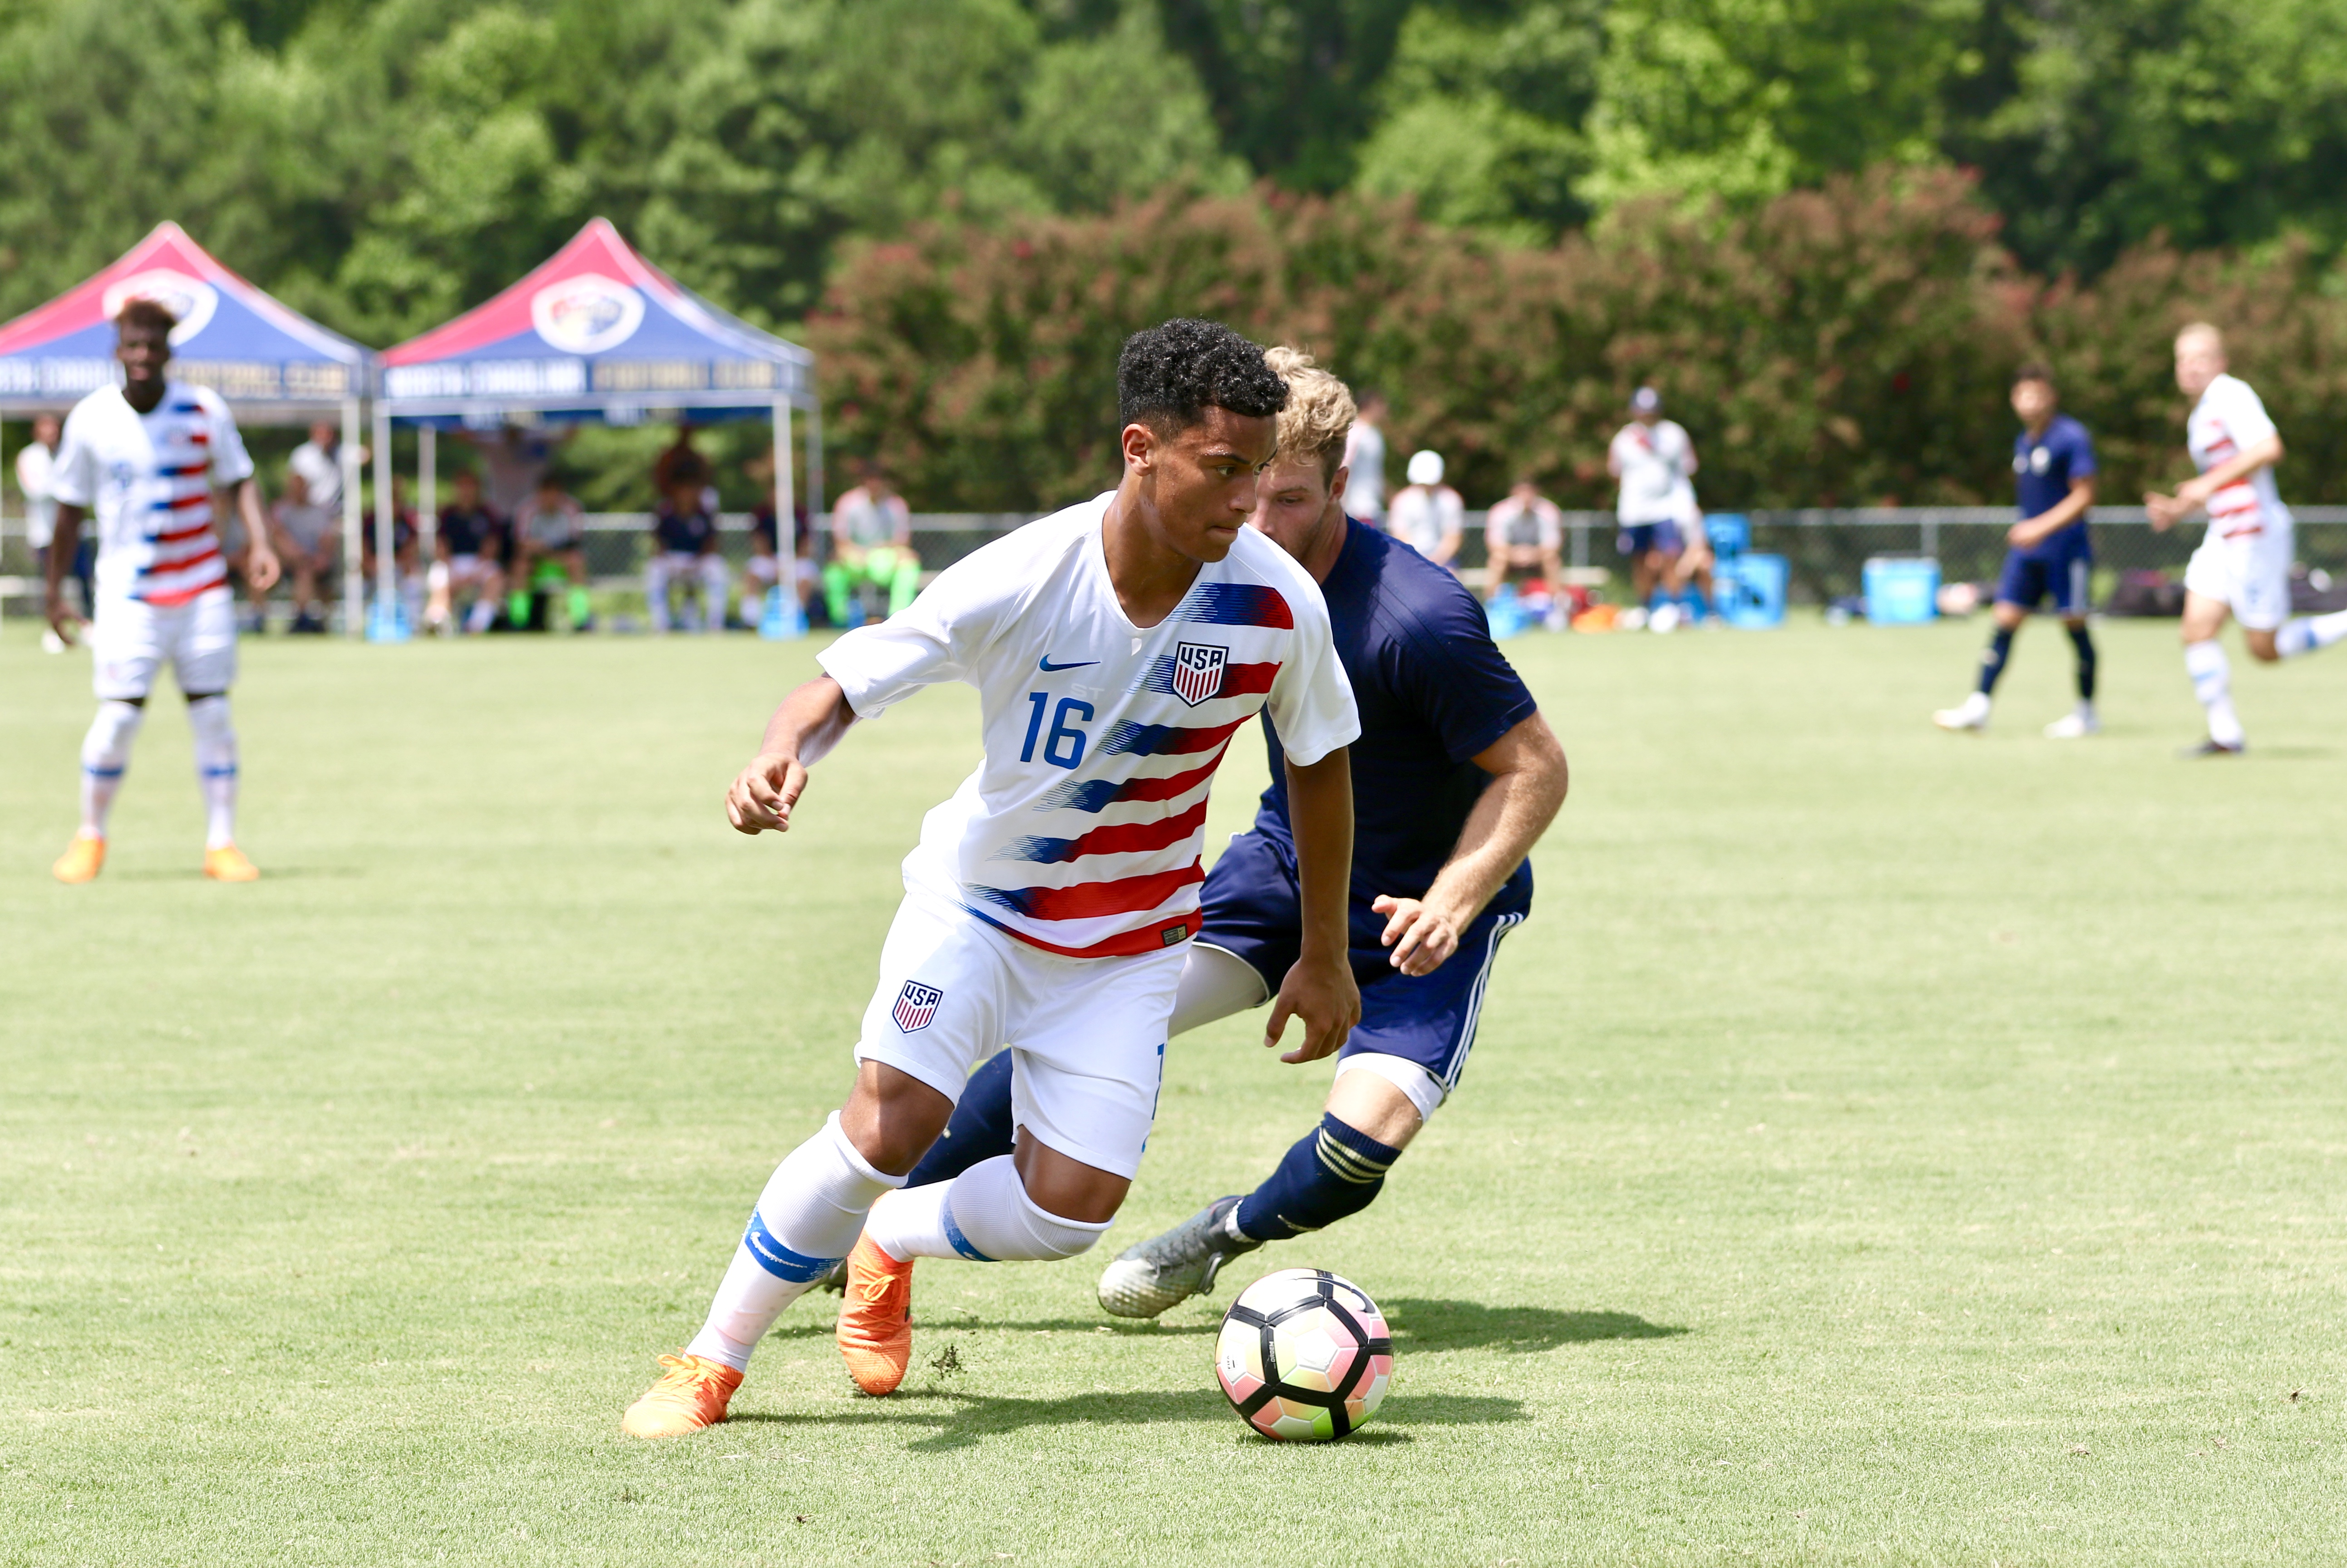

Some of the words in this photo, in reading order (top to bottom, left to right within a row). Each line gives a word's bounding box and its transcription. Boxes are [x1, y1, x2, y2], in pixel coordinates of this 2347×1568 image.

[1181, 647, 1223, 670] USA
[1020, 692, 1095, 770] 16
[904, 984, 938, 1006] USA
